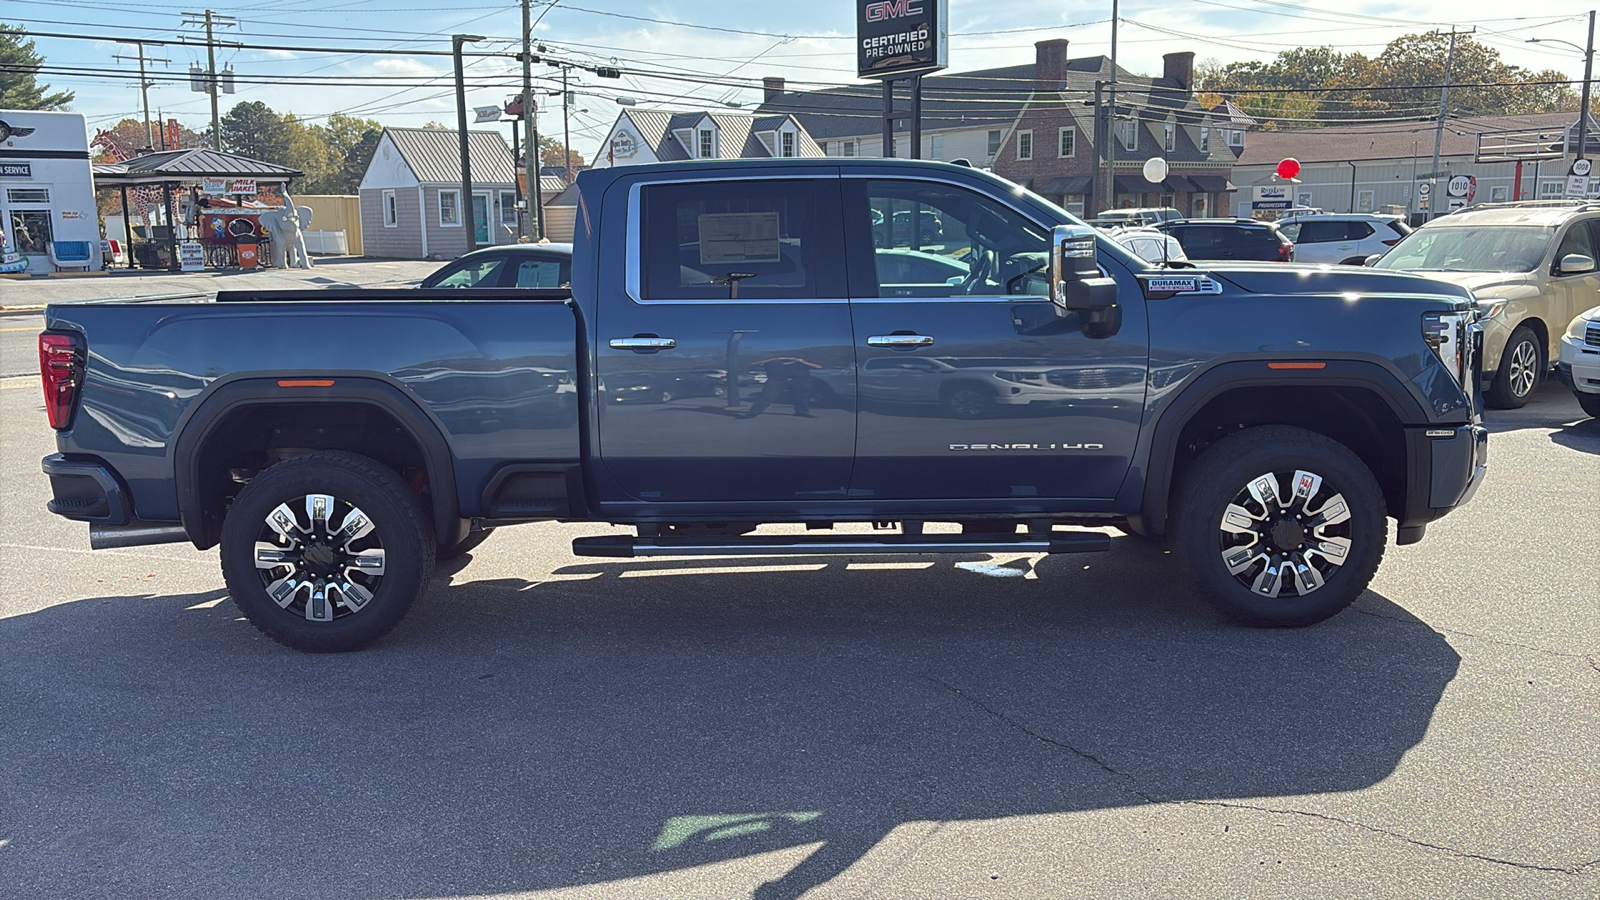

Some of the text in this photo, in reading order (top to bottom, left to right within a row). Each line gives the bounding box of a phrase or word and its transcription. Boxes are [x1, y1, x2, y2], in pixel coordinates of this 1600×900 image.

[866, 0, 923, 22] GMC
[863, 30, 928, 48] CERTIFIED
[866, 41, 925, 58] PRE-OWNED
[4, 166, 29, 175] SERVICE
[1452, 182, 1468, 190] 1010
